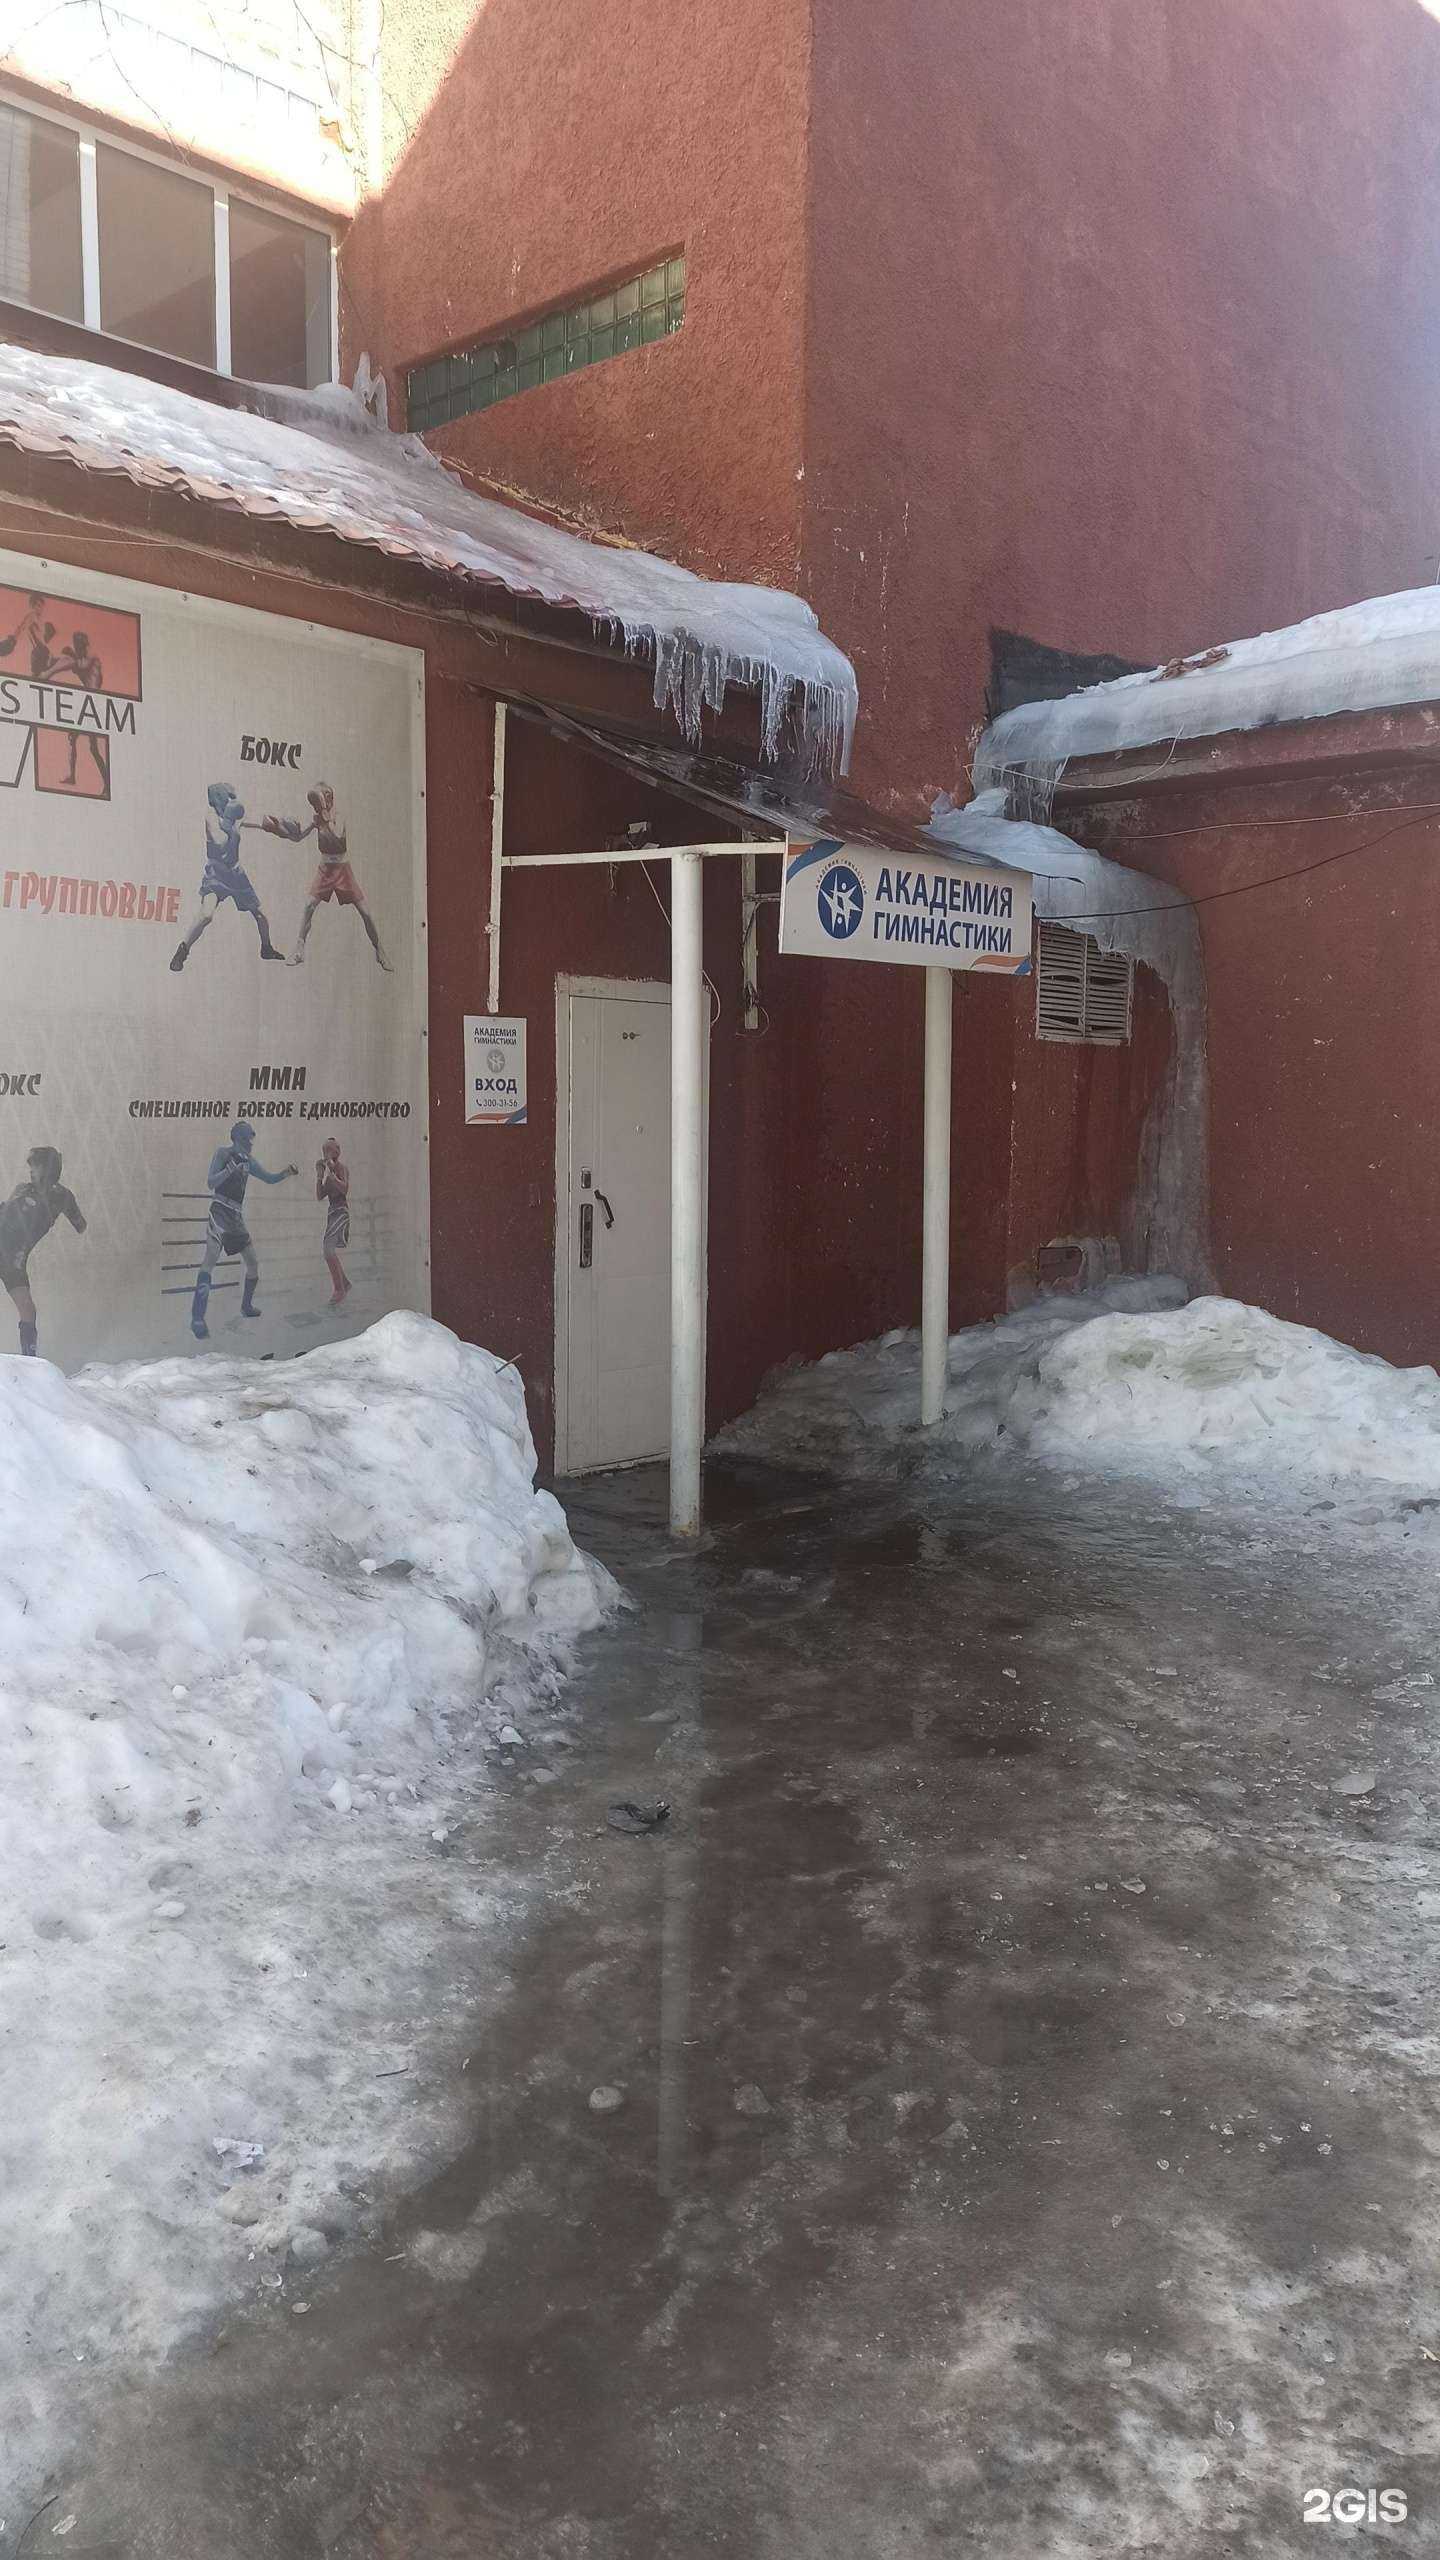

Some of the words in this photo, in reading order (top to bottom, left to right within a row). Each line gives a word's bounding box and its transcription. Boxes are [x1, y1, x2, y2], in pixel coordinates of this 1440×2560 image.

[29, 684, 136, 735] TEAM
[240, 734, 302, 769] БОКС
[3, 871, 181, 923] ГРУППОВЫЕ
[875, 867, 1013, 918] АКАДЕМИЯ
[873, 911, 1012, 953] ГИМНАСТИКИ
[474, 1026, 517, 1039] АКАДЕМИЯ
[474, 1036, 517, 1046] ГИМНАСТИКИ
[249, 1066, 307, 1091] ММА
[475, 1078, 517, 1094] ВХОД
[128, 1100, 231, 1119] СМЕШАННОЕ
[237, 1101, 293, 1119] БОЕВОЕ
[300, 1102, 411, 1121] ЕДИНОБОРСТВО
